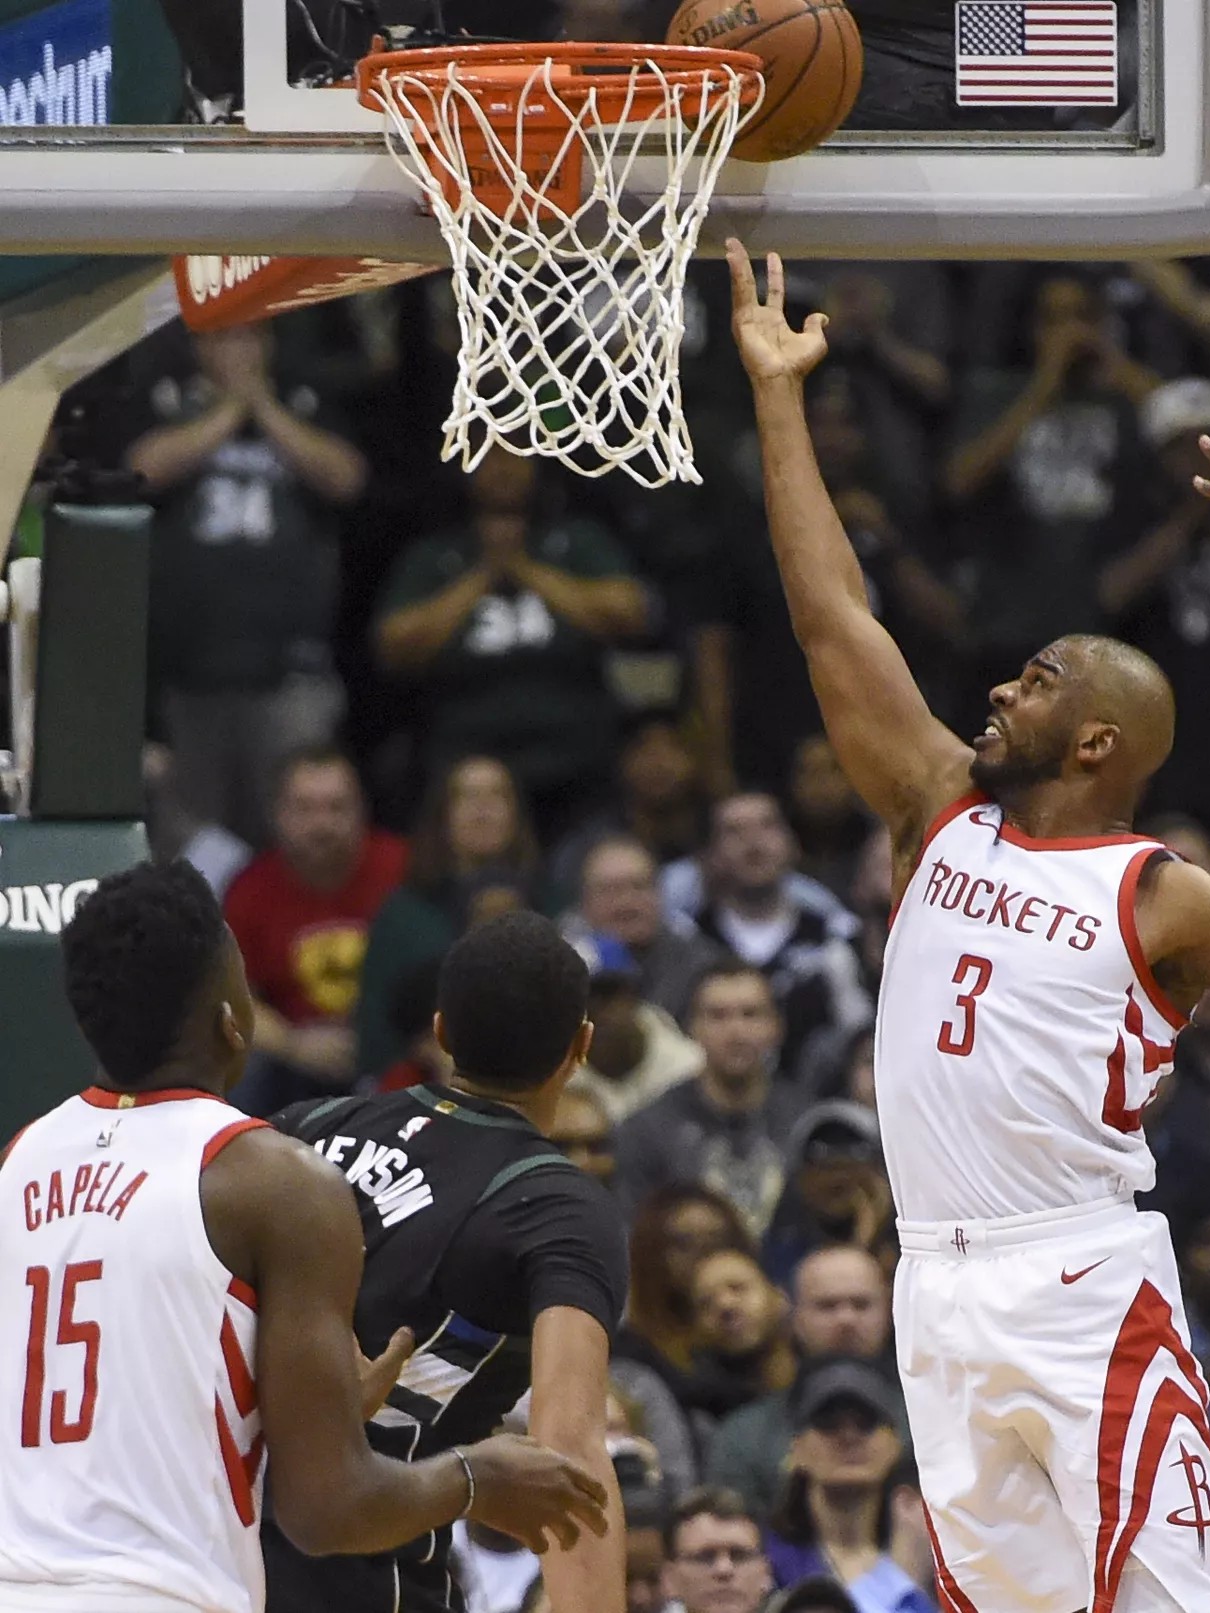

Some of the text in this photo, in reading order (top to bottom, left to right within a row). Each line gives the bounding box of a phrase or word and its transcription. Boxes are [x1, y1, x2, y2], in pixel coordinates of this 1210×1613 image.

[923, 856, 1103, 952] ROCKETS
[937, 953, 993, 1057] 3
[23, 1161, 149, 1232] CAPELA
[21, 1260, 103, 1449] 15
